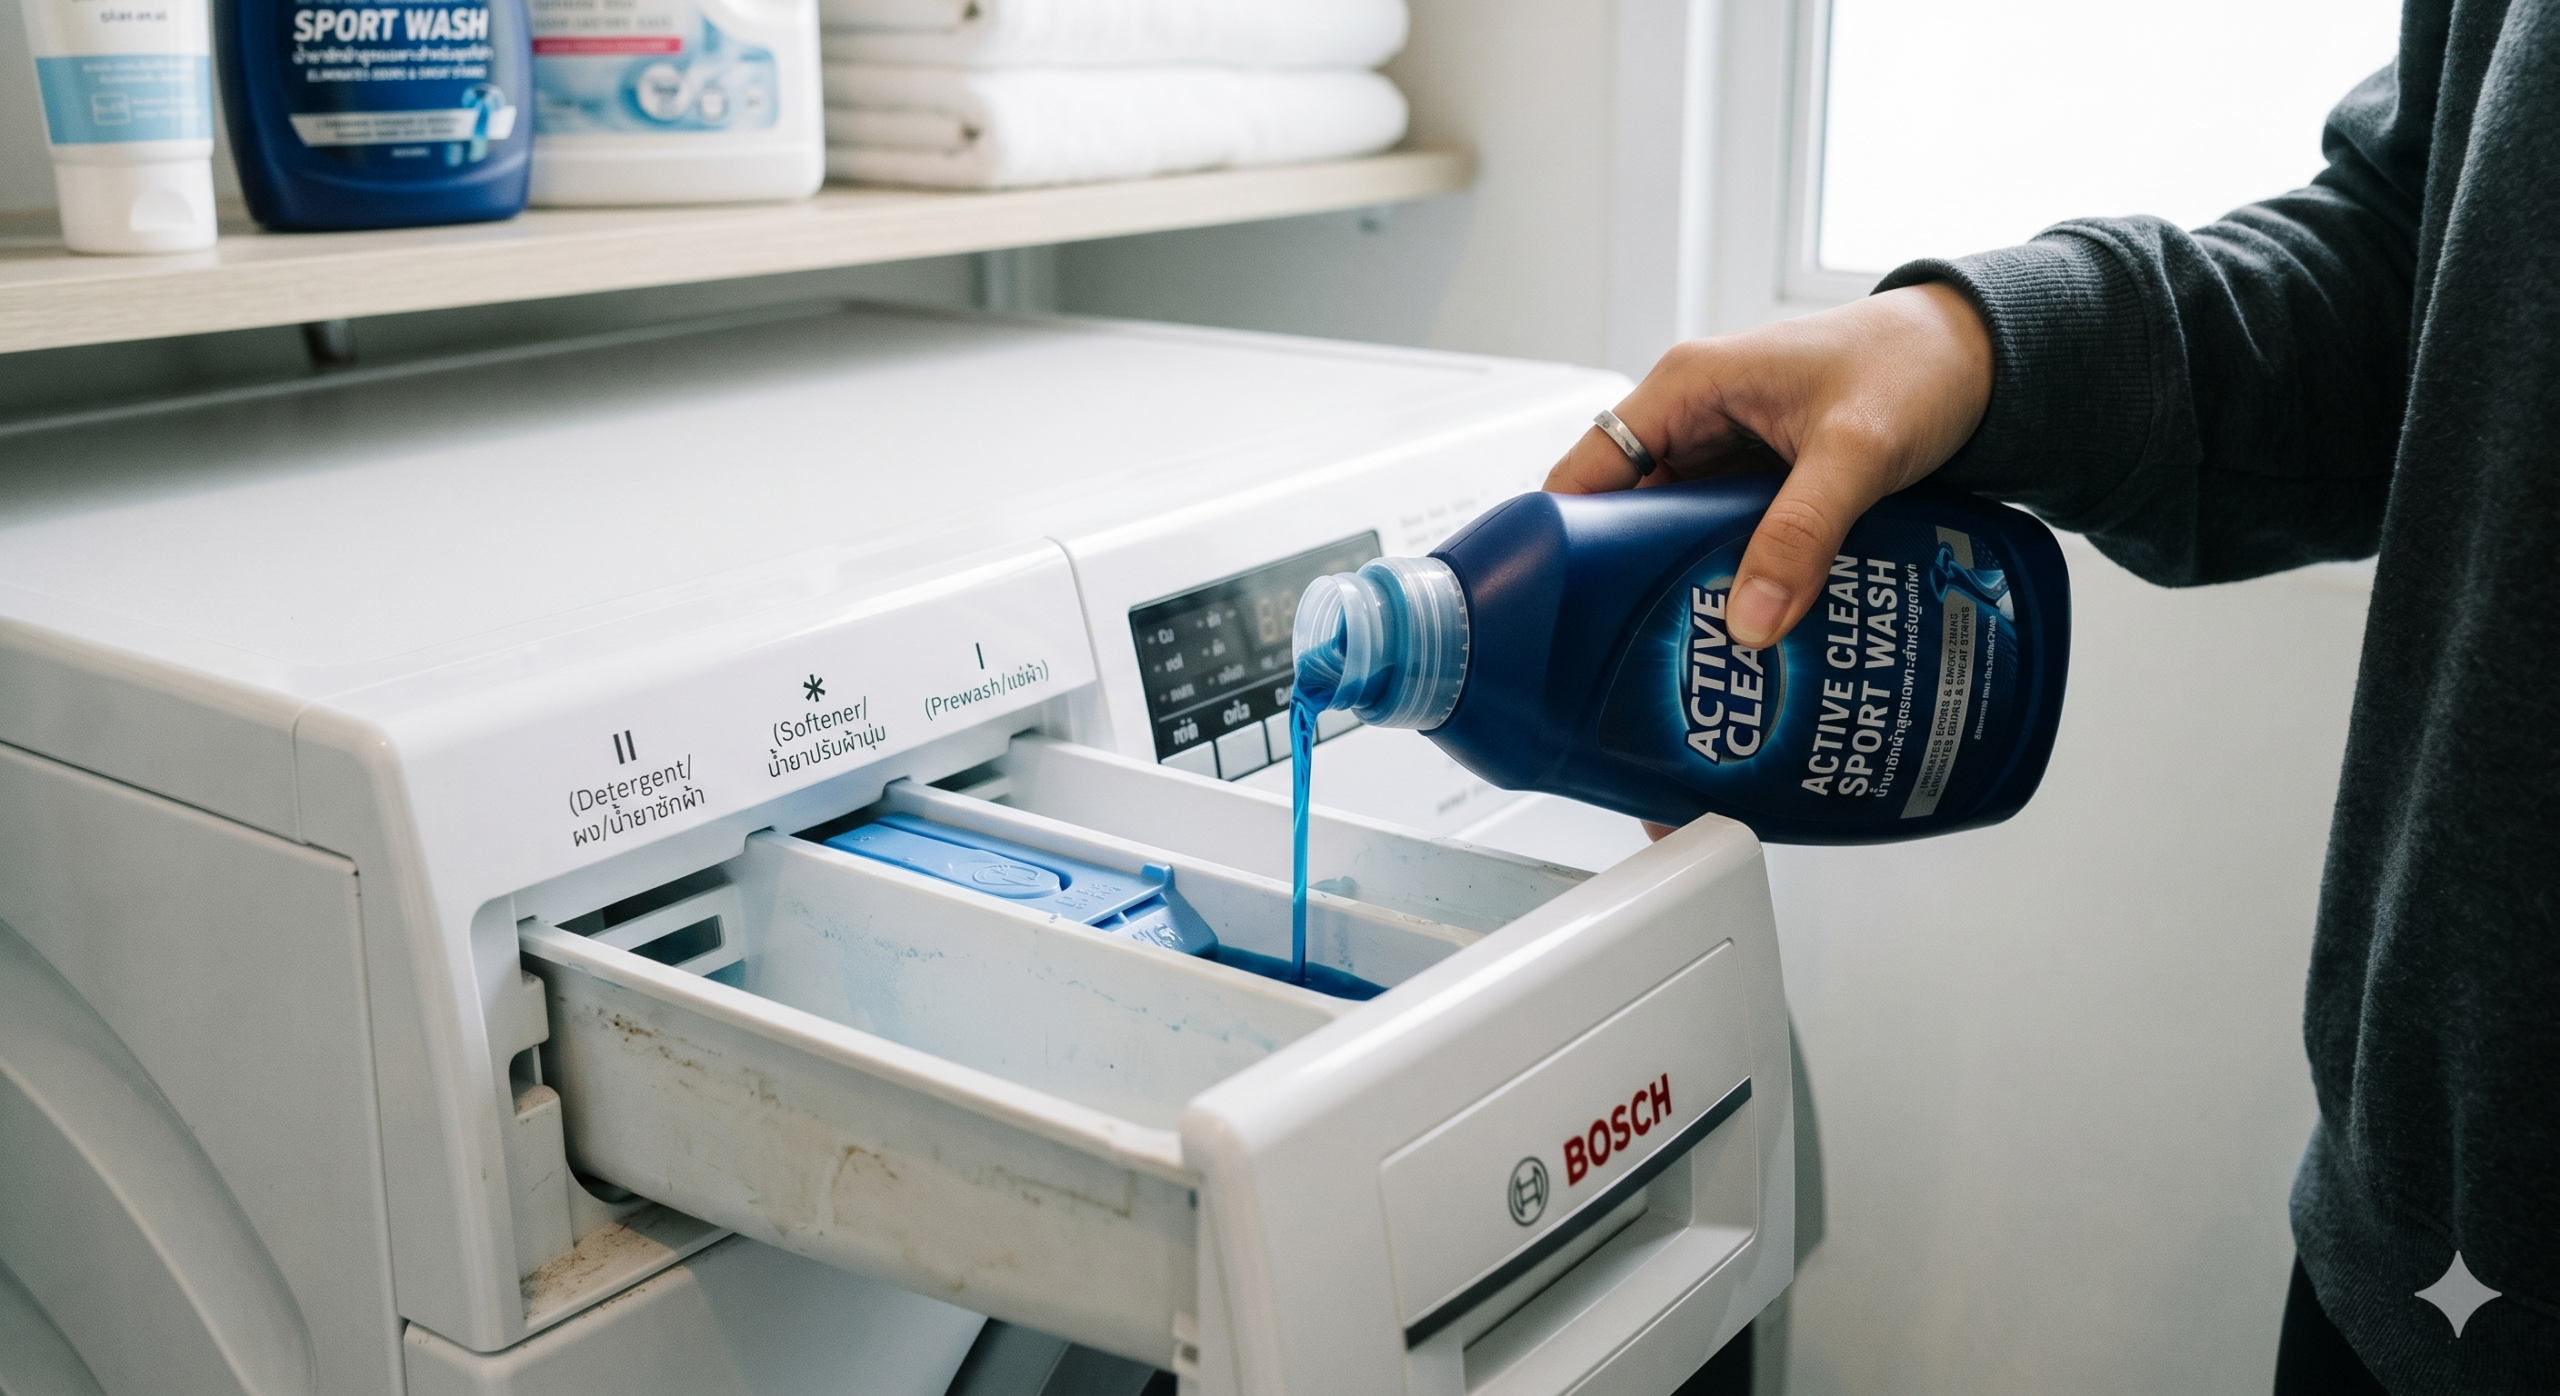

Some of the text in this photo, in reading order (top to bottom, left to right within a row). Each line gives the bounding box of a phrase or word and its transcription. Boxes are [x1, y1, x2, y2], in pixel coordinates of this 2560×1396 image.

[293, 7, 489, 42] SPORT WASH
[1687, 587, 1727, 762] ACTIVE
[1726, 643, 1764, 758] CLEA
[1801, 555, 1859, 796] ACTIVE CLEAN
[1838, 560, 1898, 798] SPORT WASH
[612, 730, 637, 765] II
[768, 722, 886, 778] น้ำยาปรับผ้านุ่ม
[773, 695, 867, 748] (Softener/
[569, 753, 691, 818] (Detergent/
[572, 785, 706, 847] ผง/น้ำยาซักผ้า
[1563, 1072, 1673, 1187] BOSCH
